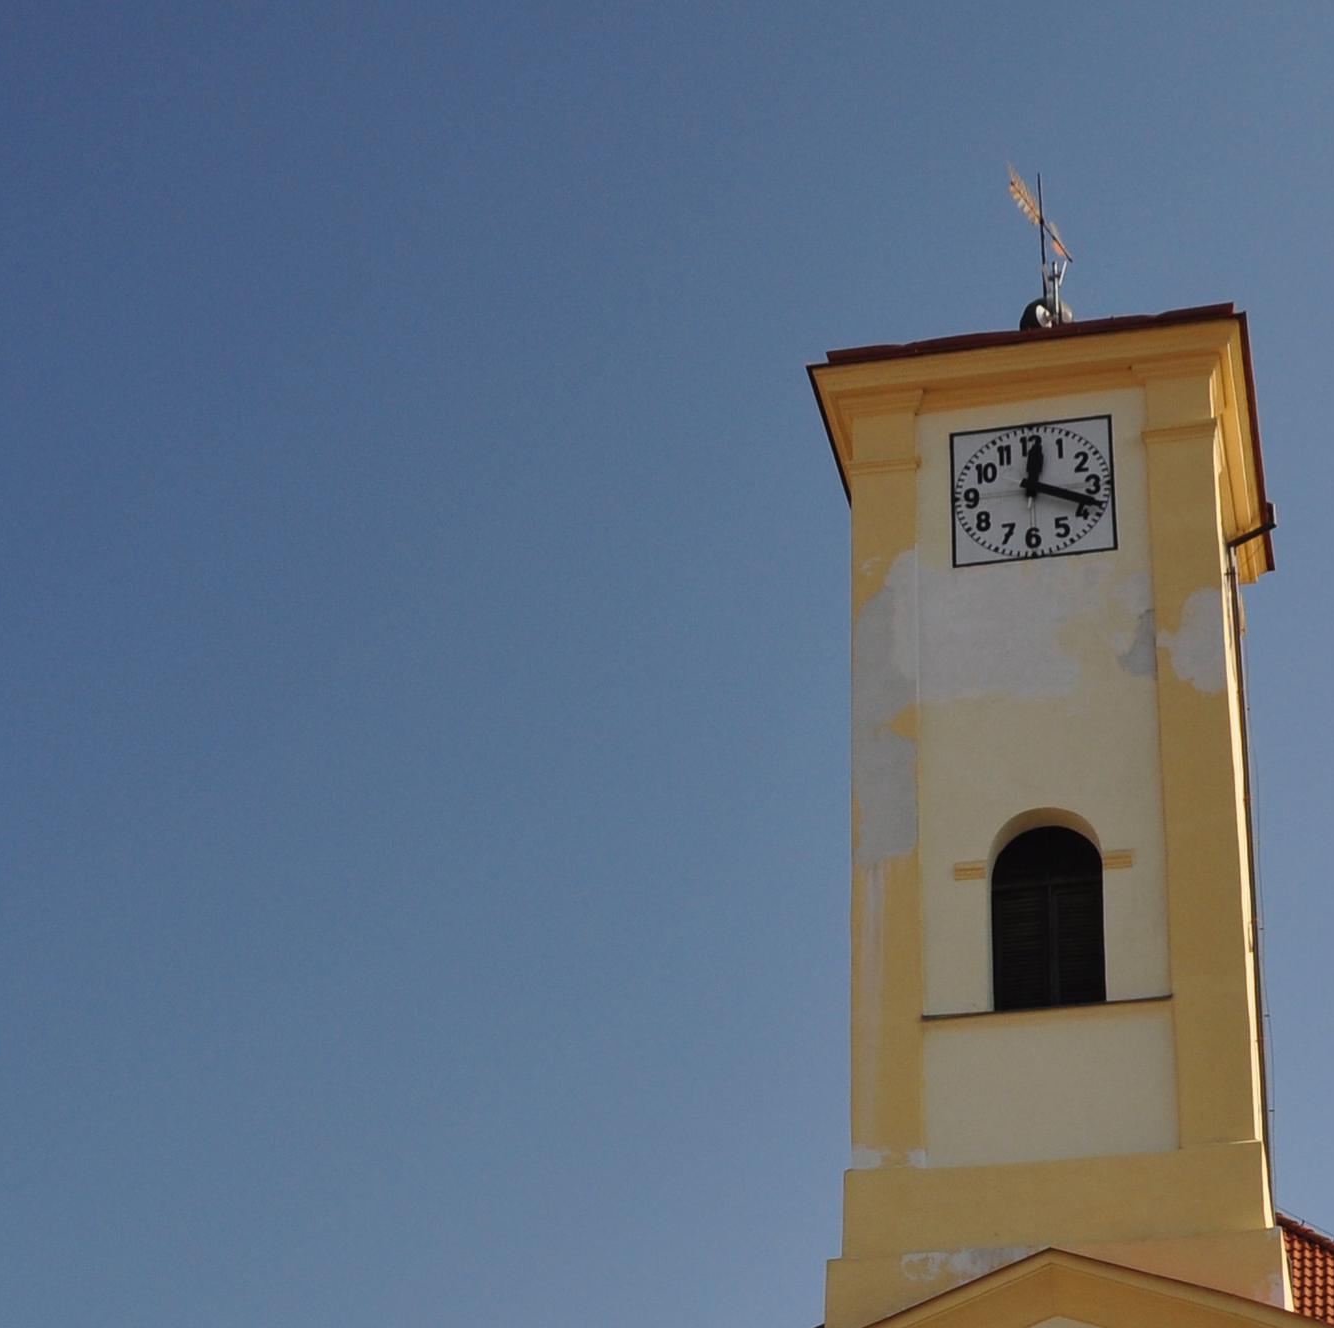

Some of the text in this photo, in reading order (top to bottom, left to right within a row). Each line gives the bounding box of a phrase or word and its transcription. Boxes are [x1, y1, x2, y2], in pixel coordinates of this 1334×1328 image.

[997, 444, 1012, 466] 11
[1055, 438, 1064, 459] 1
[975, 462, 998, 484] 10
[1074, 451, 1089, 473] 2
[1085, 474, 1101, 495] 3
[963, 488, 980, 509] 9
[976, 511, 991, 532] 8
[1075, 502, 1091, 520] 4
[1001, 522, 1016, 545] 7
[1025, 527, 1042, 549] 6
[1054, 516, 1070, 538] 5
